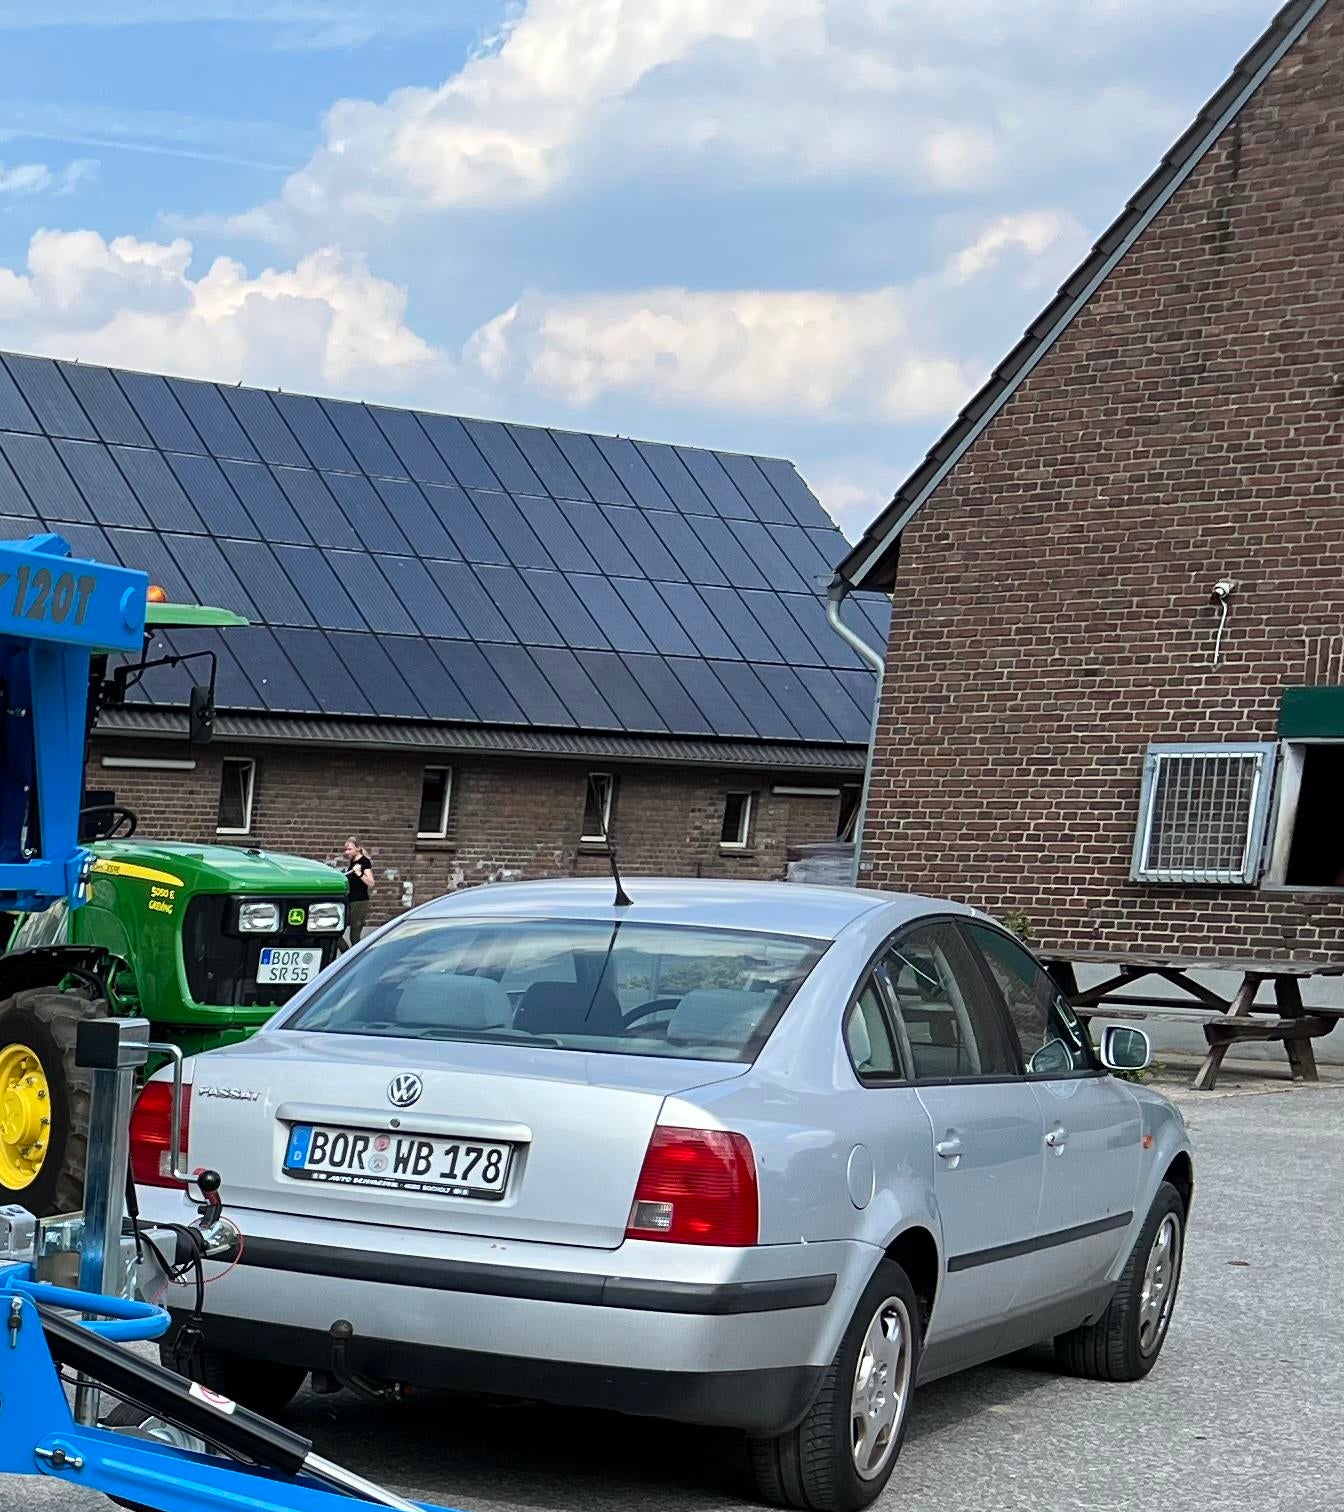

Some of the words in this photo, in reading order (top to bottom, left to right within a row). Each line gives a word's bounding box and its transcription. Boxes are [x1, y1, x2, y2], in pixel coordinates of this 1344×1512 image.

[12, 564, 98, 627] 120T
[271, 952, 300, 966] BOR
[269, 967, 288, 981] SR
[290, 967, 309, 981] 55
[198, 1085, 261, 1101] PASSAT
[294, 1150, 302, 1161] D
[308, 1131, 370, 1170] BOR
[393, 1139, 434, 1176] WB
[440, 1144, 503, 1184] 178
